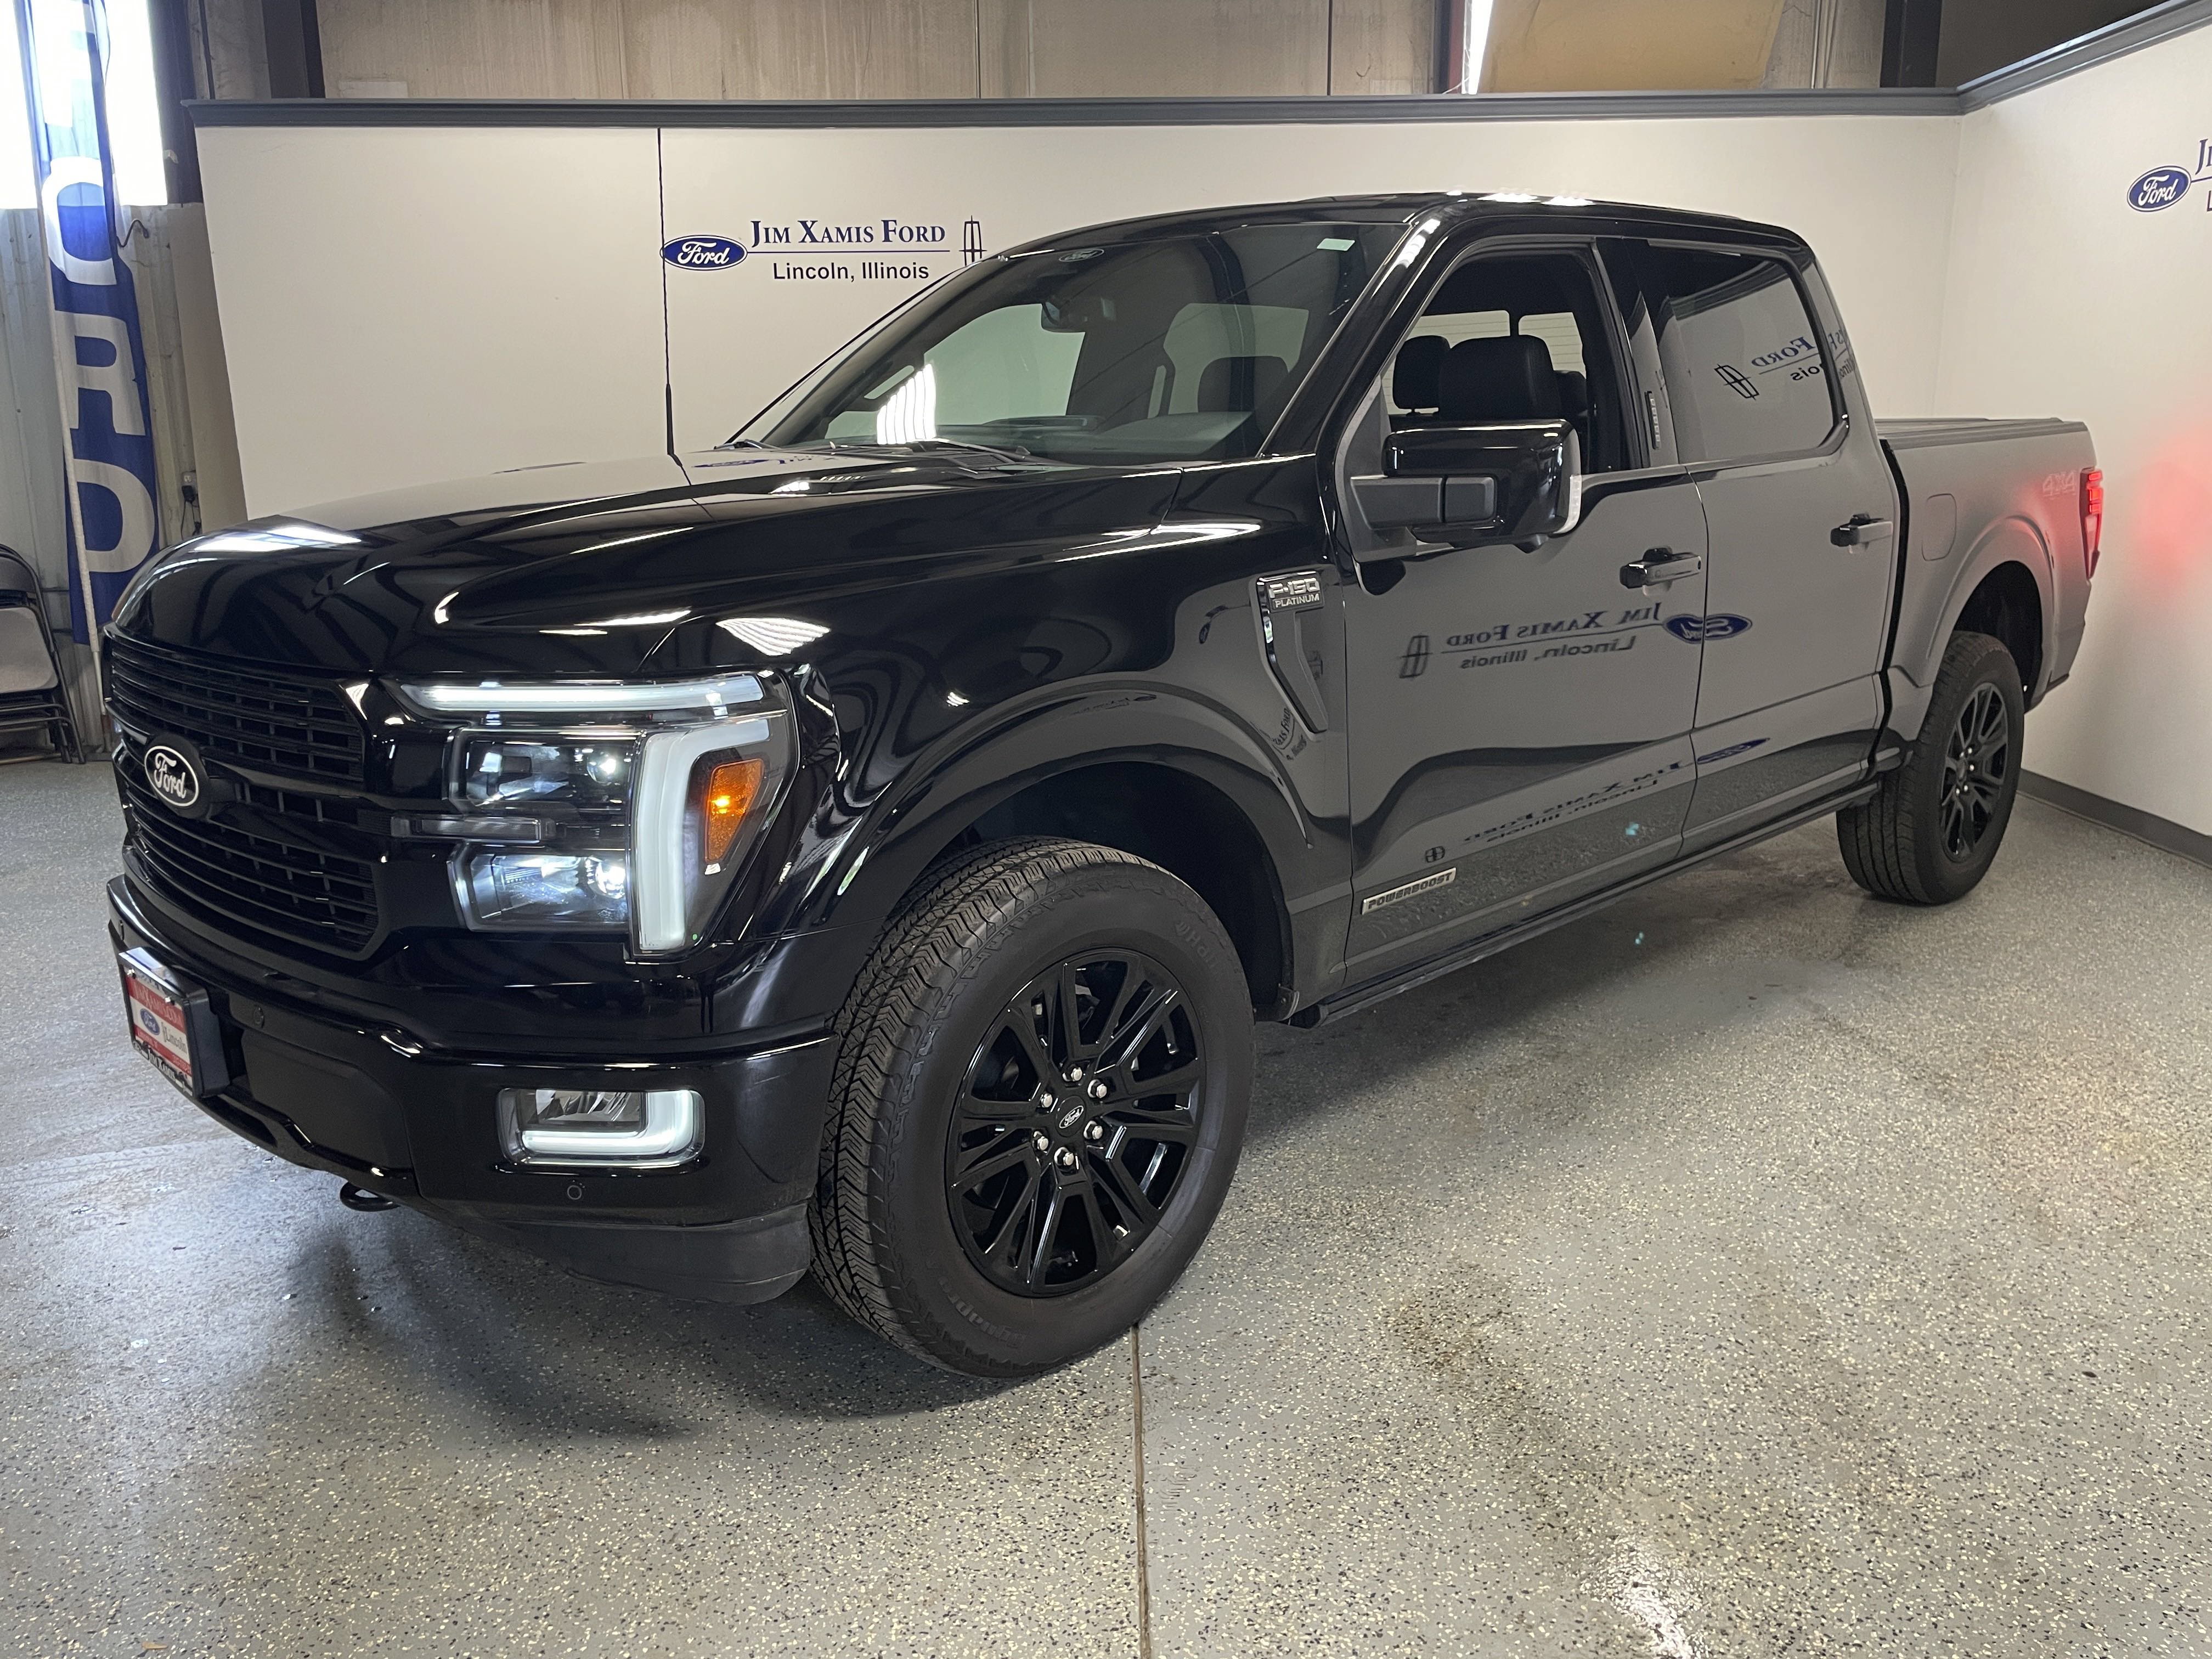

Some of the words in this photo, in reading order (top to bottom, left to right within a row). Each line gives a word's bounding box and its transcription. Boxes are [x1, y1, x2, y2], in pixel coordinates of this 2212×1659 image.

[2138, 174, 2179, 206] Ford
[751, 221, 791, 248] JIM
[798, 220, 874, 243] XAMIS
[881, 219, 945, 243] FORD
[677, 241, 730, 265] Ford
[773, 262, 855, 282] Lincoln,
[862, 262, 929, 280] Illinois
[1268, 577, 1321, 599] F-150
[1274, 593, 1319, 608] PLATINUM
[154, 752, 187, 799] Ford
[1368, 872, 1453, 910] POWERBOOST
[1064, 1108, 1080, 1126] Ford
